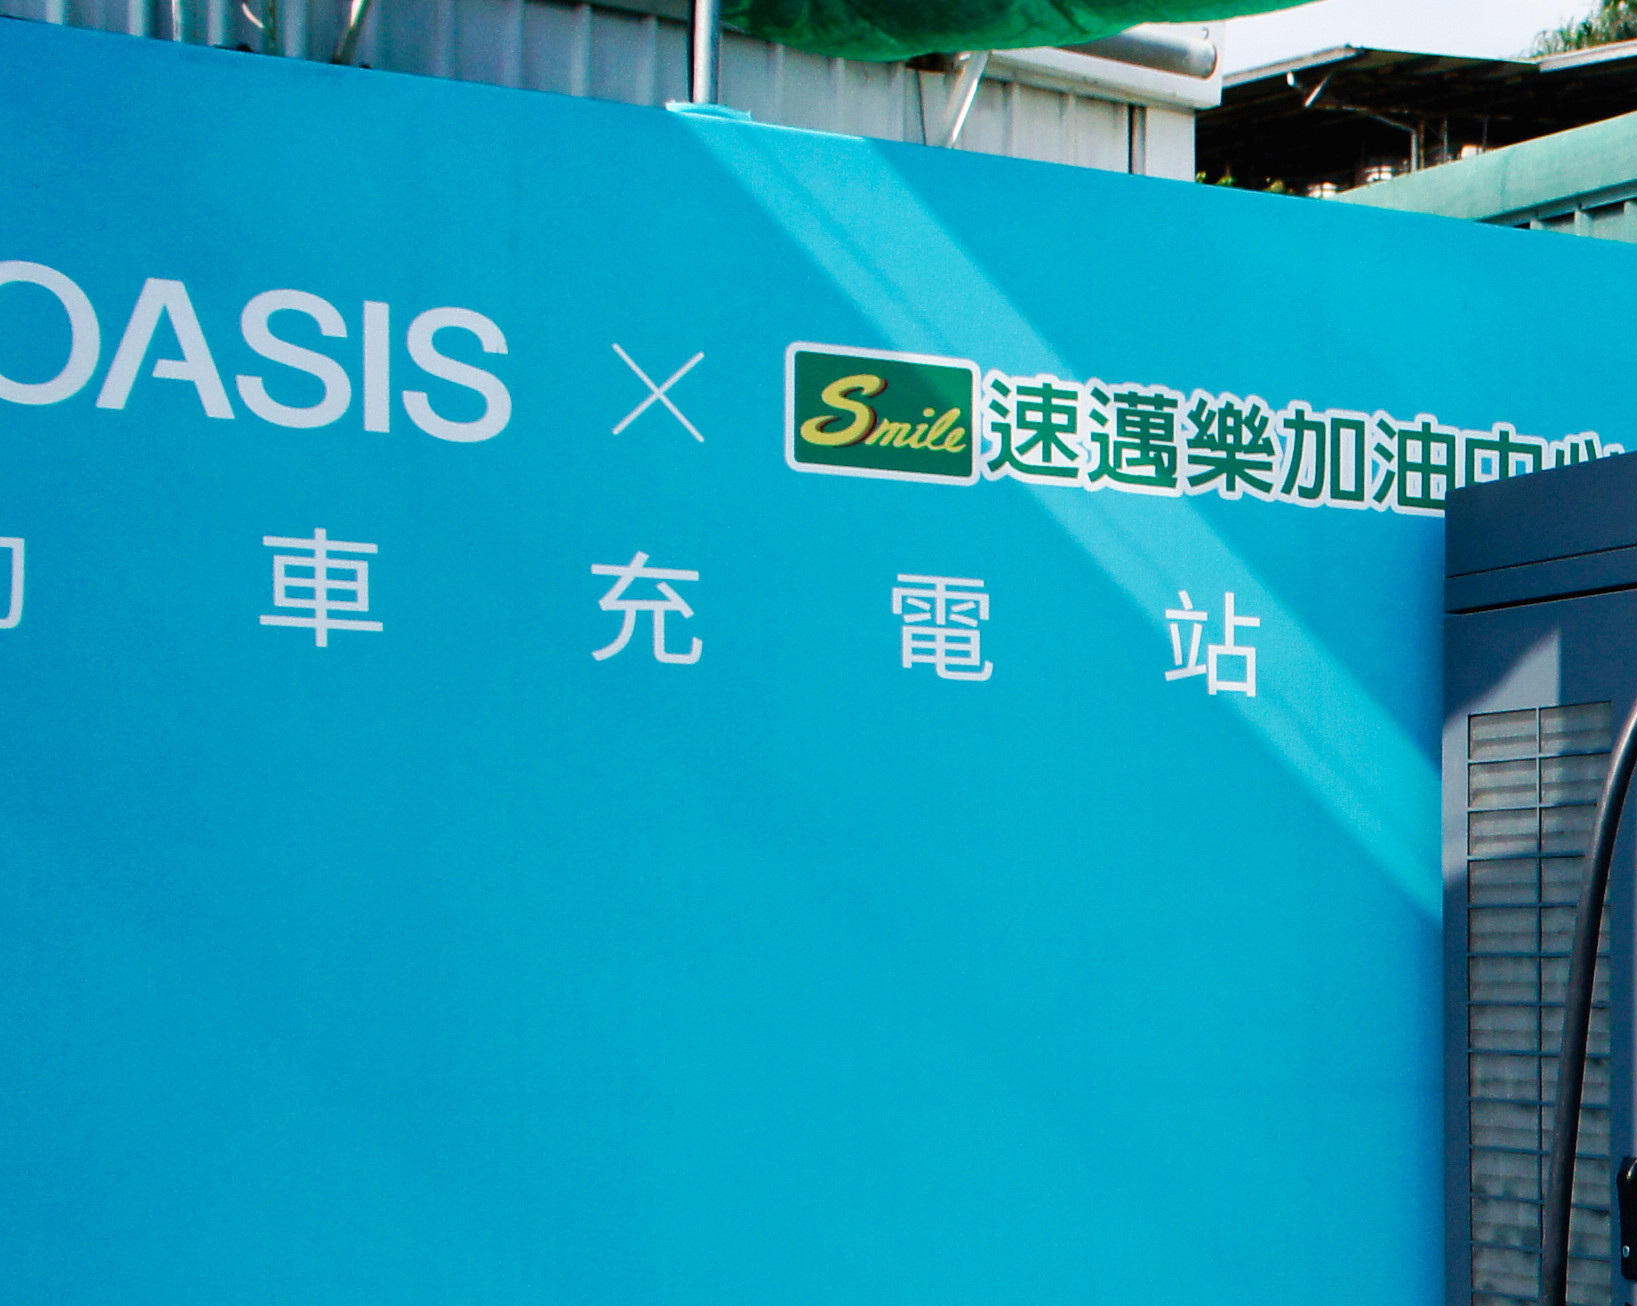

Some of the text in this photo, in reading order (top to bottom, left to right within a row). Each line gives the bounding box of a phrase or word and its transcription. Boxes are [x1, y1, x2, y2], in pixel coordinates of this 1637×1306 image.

[0, 260, 512, 443] OASIS
[799, 373, 968, 457] Smile
[986, 376, 1620, 511] 速邁樂加油中
[0, 527, 1262, 698] 車充電站
